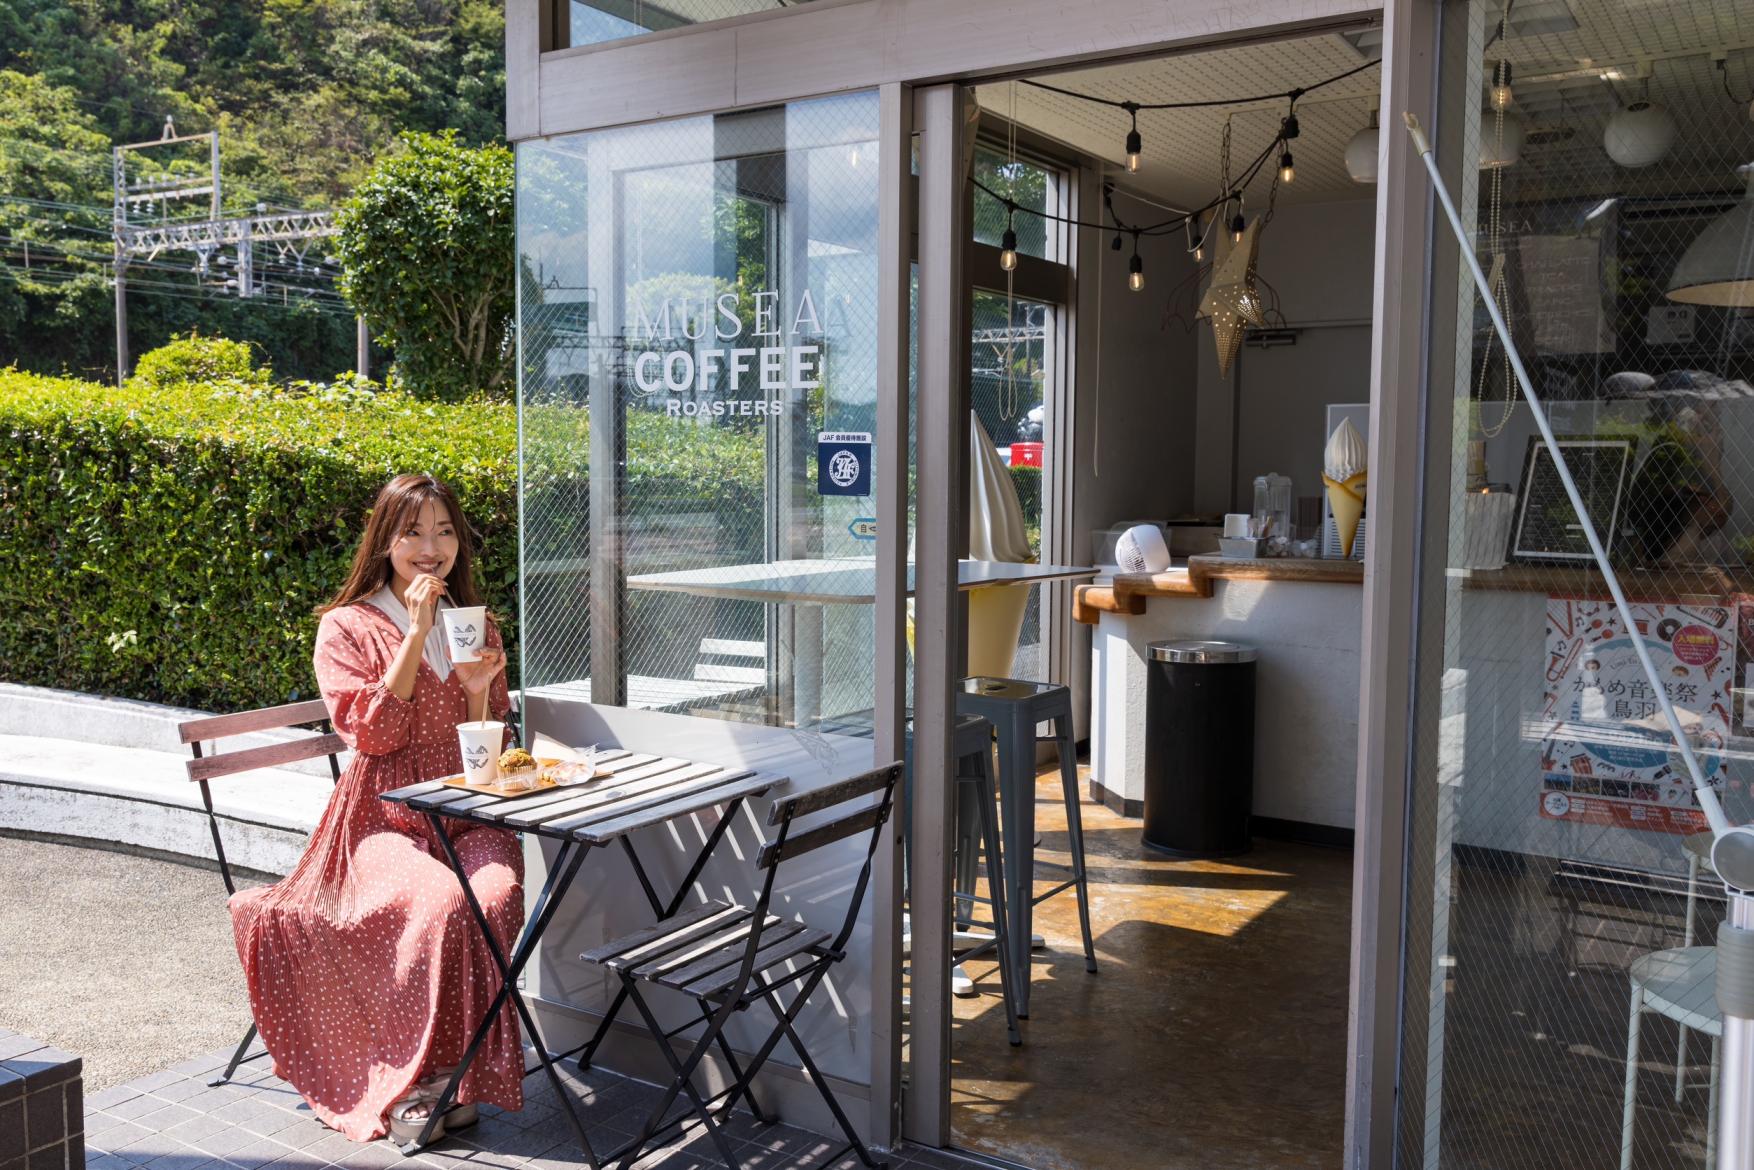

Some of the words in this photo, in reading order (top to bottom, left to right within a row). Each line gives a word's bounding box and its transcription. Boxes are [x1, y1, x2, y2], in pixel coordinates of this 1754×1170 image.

[1478, 219, 1533, 235] MSEA
[632, 289, 824, 342] MUSEA
[635, 345, 819, 392] COFFEE
[667, 399, 784, 416] ROASTERS
[1611, 699, 1656, 720] 鳥羽
